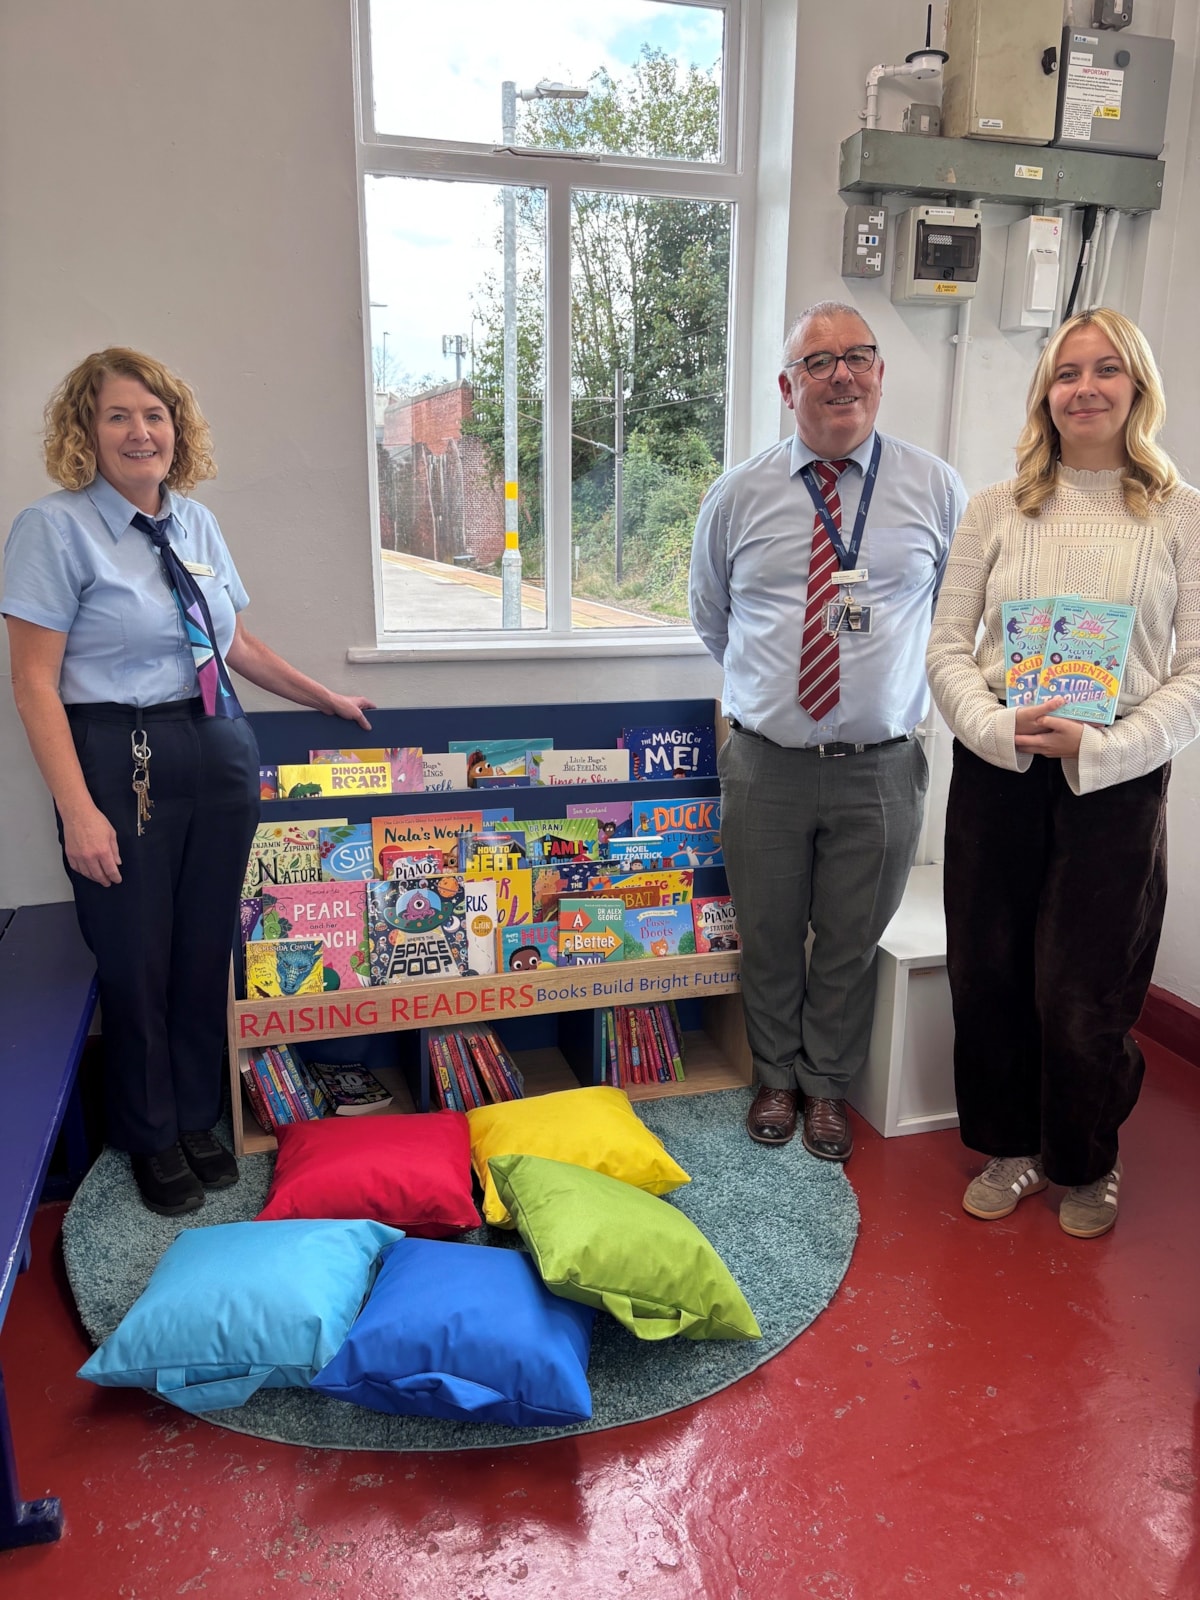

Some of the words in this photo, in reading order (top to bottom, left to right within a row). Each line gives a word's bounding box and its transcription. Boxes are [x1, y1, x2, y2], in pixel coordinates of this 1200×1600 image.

[1082, 68, 1110, 76] IMPORTANT
[1044, 661, 1114, 688] ACCIDENTAL
[1059, 678, 1094, 692] TIME
[1041, 690, 1106, 705] TAVELLER
[652, 730, 694, 746] MAGIC
[577, 763, 608, 771] FEELINGS
[644, 746, 699, 773] ME!
[331, 766, 386, 776] DINOSAUR
[332, 775, 387, 789] ROAR!
[653, 803, 714, 832] DUCK
[384, 826, 431, 844] Nala's
[252, 841, 281, 849] ENJAMIN
[478, 846, 497, 854] HOW
[499, 845, 510, 853] TO
[543, 839, 595, 856] FAMILY
[611, 851, 663, 861] FITZPATRICK
[396, 863, 432, 879] PIANO
[570, 881, 583, 889] THE
[293, 900, 356, 921] PEARL
[704, 907, 736, 924] PIANO
[573, 913, 584, 928] A
[710, 924, 734, 932] STATION
[290, 943, 314, 952] COWELL
[394, 940, 449, 959] SPACE
[389, 955, 453, 978] POO?
[240, 1000, 378, 1039] RAISING
[391, 984, 535, 1022] READERS
[537, 985, 586, 1002] Books
[593, 978, 633, 996] Build
[639, 973, 689, 995] Bright
